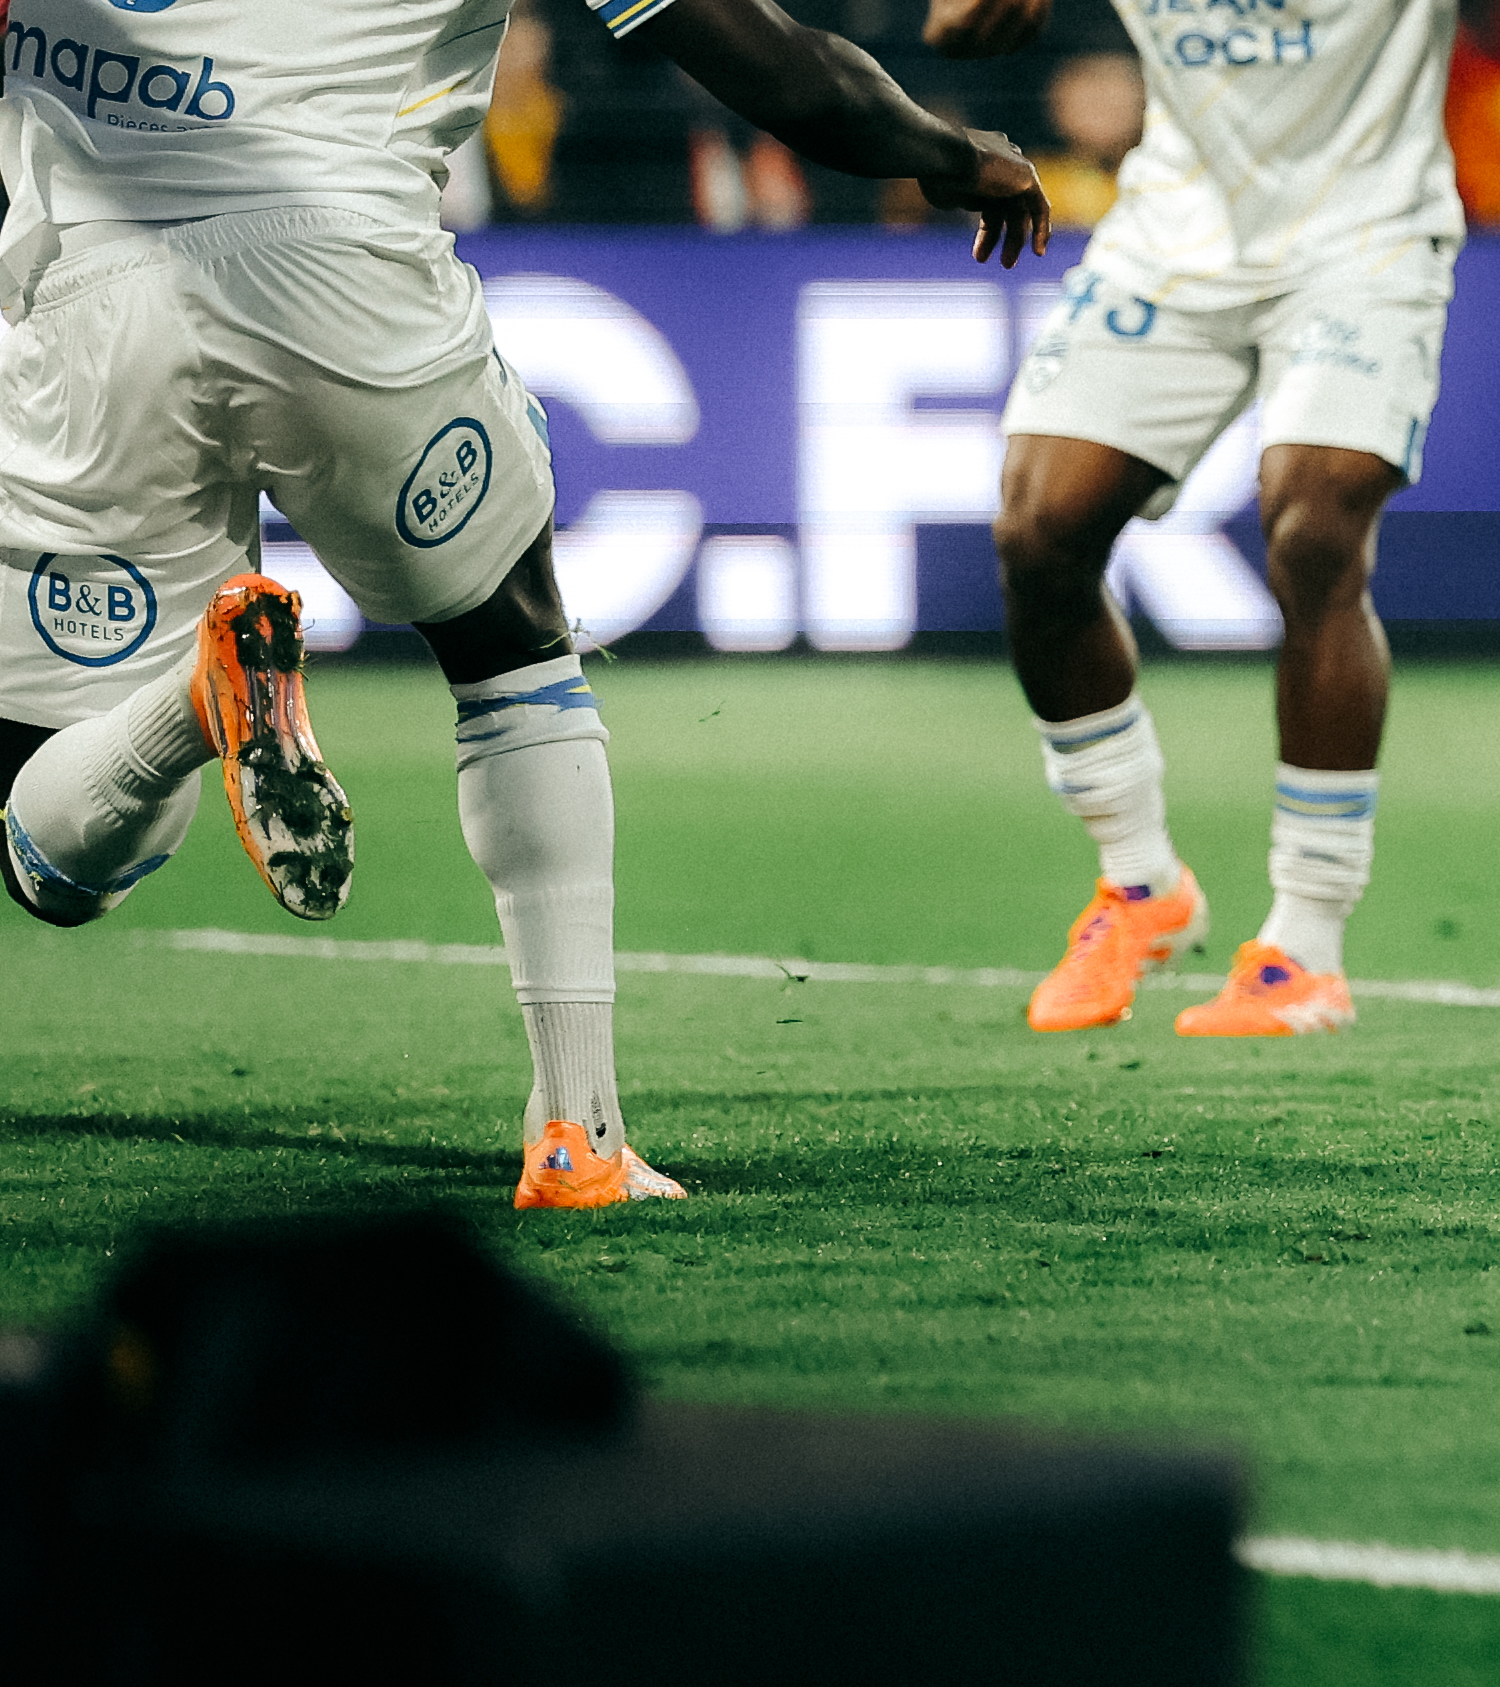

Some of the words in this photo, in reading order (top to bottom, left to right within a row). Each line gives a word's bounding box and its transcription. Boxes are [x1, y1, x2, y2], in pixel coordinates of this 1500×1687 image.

[8, 20, 236, 121] mapab
[428, 472, 479, 533] HOTELS
[53, 617, 124, 641] HOTELS
